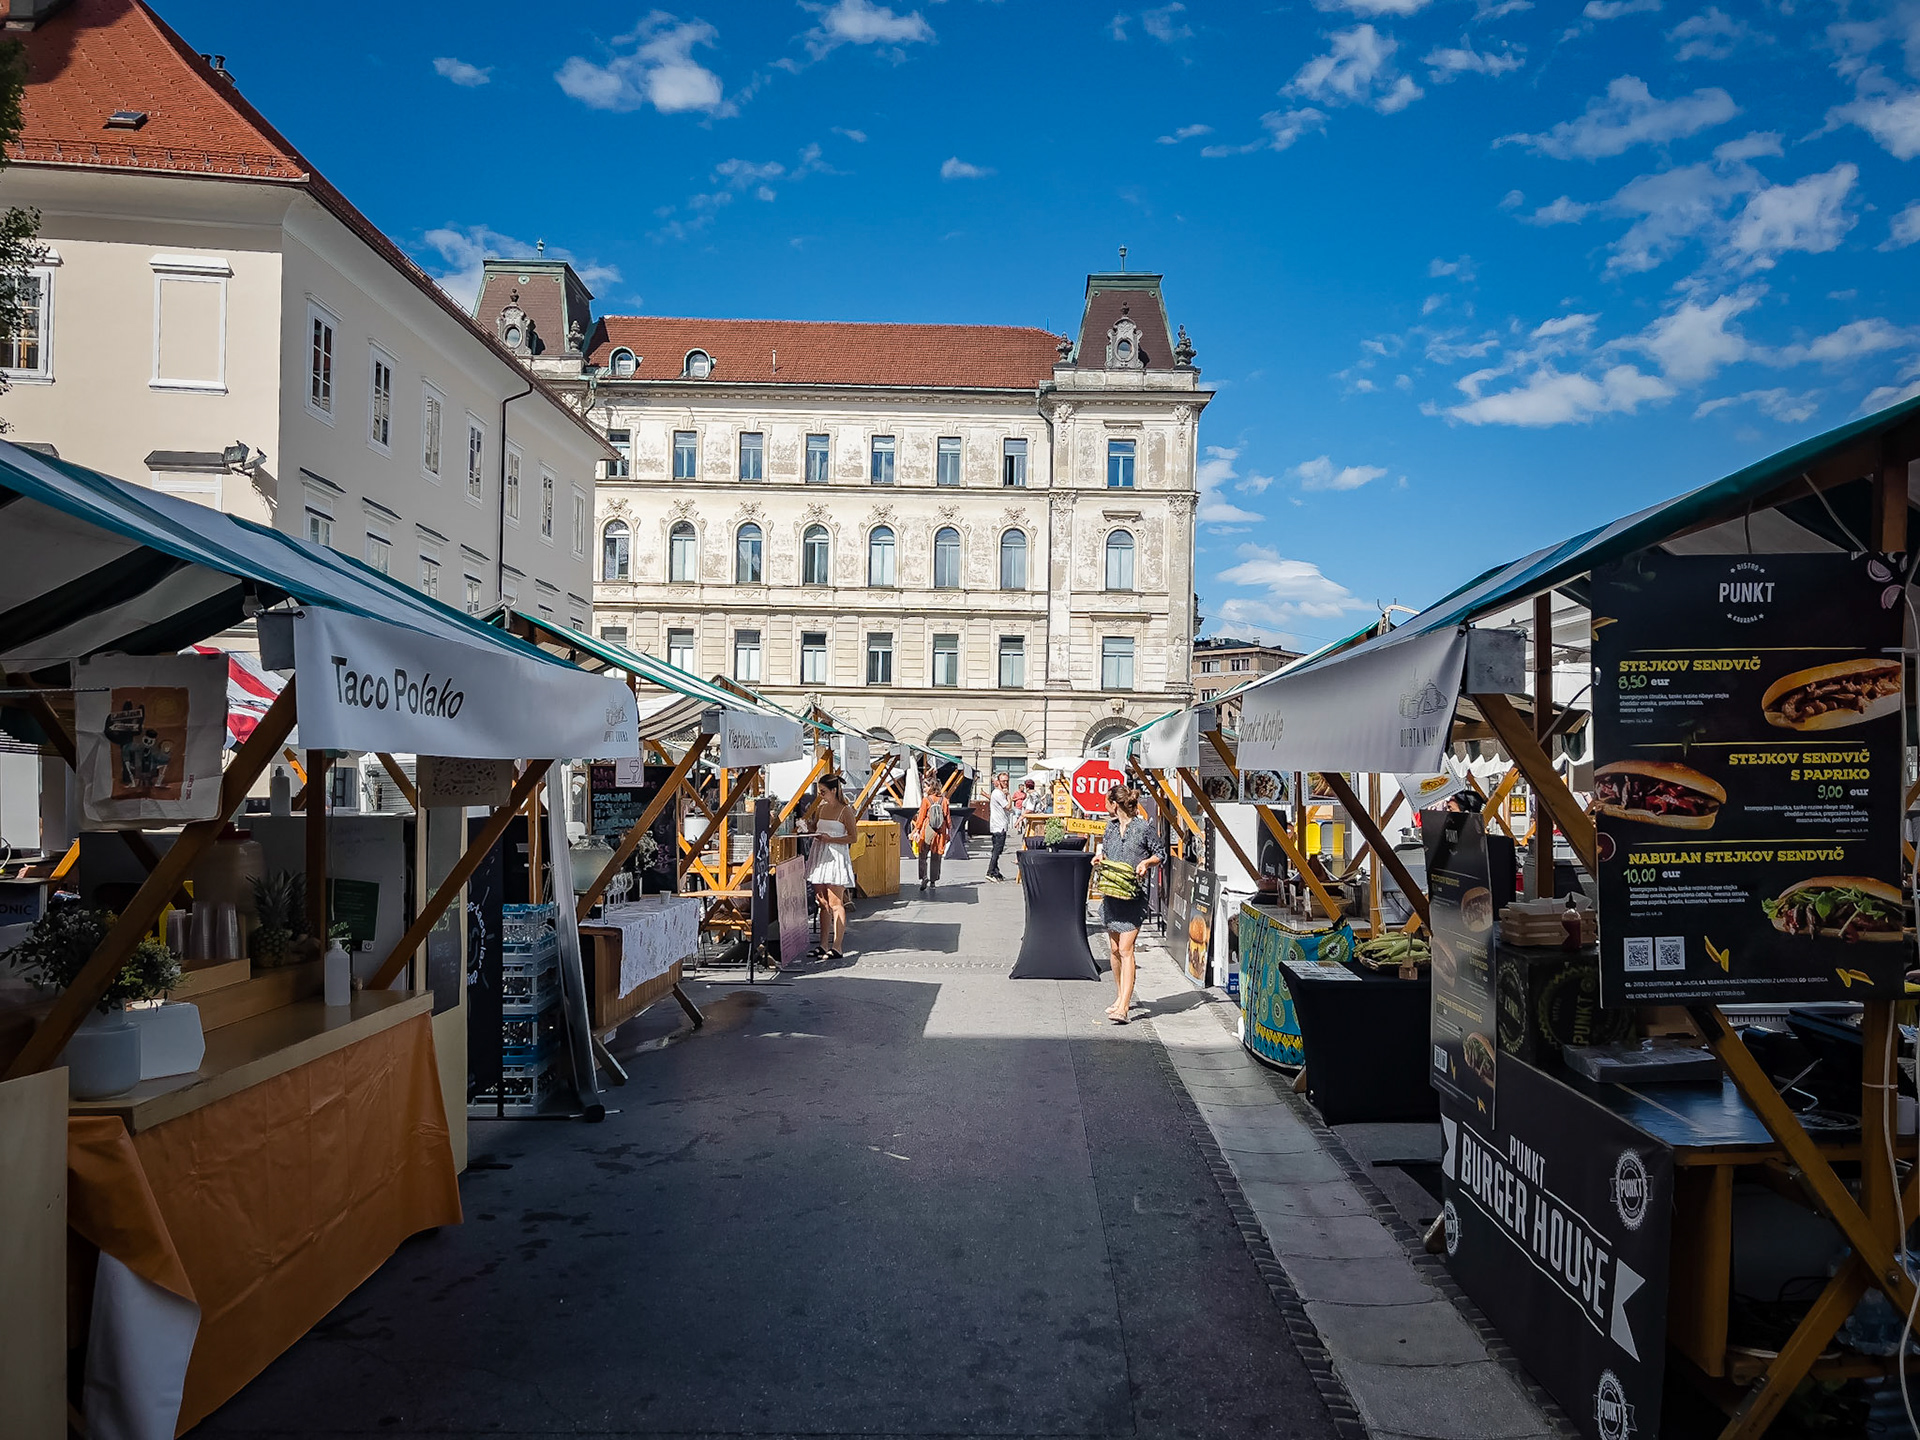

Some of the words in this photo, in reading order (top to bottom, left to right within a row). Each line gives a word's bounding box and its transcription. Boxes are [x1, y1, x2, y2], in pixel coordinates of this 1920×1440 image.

[1719, 582, 1775, 603] PUNKT
[1619, 660, 1690, 672] STEJKOV
[1693, 656, 1761, 671] SENDVIČ
[331, 655, 389, 710] Taco
[395, 668, 464, 719] Polako
[1618, 675, 1647, 690] 8,50
[1651, 678, 1670, 686] eur
[1729, 753, 1799, 765] STEJKOV
[1802, 748, 1870, 764] SENDVIČ
[1791, 769, 1800, 780] S
[1803, 768, 1870, 780] PAPRIKO
[1817, 784, 1843, 800] 9,00
[1850, 788, 1869, 796] eur
[1628, 852, 1702, 865] NABULAN
[1704, 850, 1774, 863] STEJKOV
[1777, 846, 1844, 862] SENDVIČ
[1623, 868, 1657, 884] 10,00
[1662, 870, 1681, 879] eur
[1572, 995, 1593, 1045] PUNKT
[1510, 1134, 1546, 1189] PUNKT
[1620, 1178, 1642, 1197] PUNKT
[1461, 1132, 1528, 1240] BURGER
[1533, 1194, 1609, 1319] HOUSE
[1600, 1398, 1621, 1423] PUNKT
